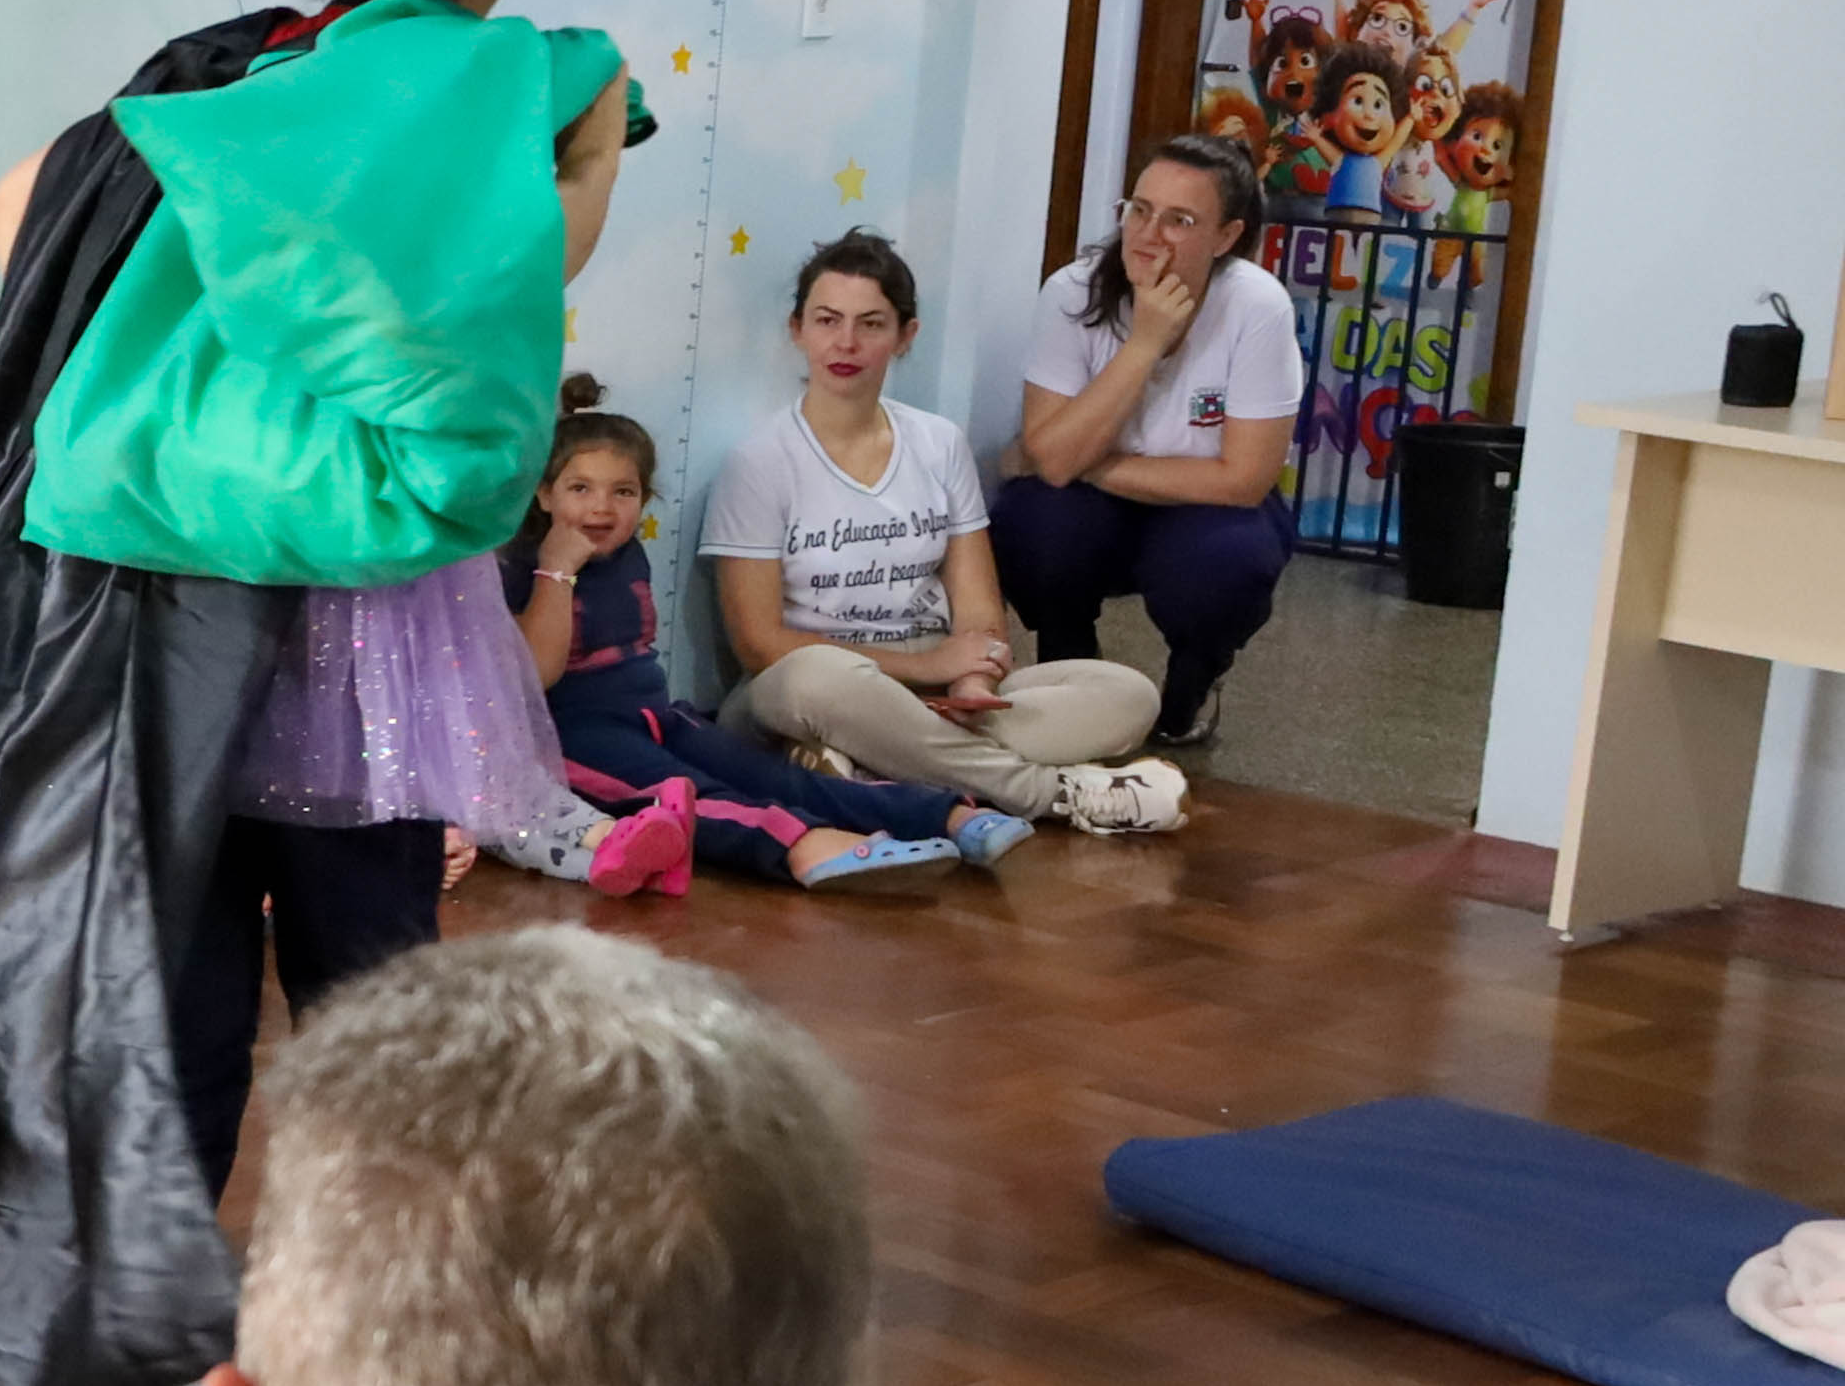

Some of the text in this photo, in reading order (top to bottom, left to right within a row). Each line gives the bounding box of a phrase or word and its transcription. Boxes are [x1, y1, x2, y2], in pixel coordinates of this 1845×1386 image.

[1330, 306, 1454, 394] DAS
[804, 530, 826, 549] na
[831, 517, 908, 552] Educação
[811, 572, 840, 596] que
[844, 560, 885, 588] cada
